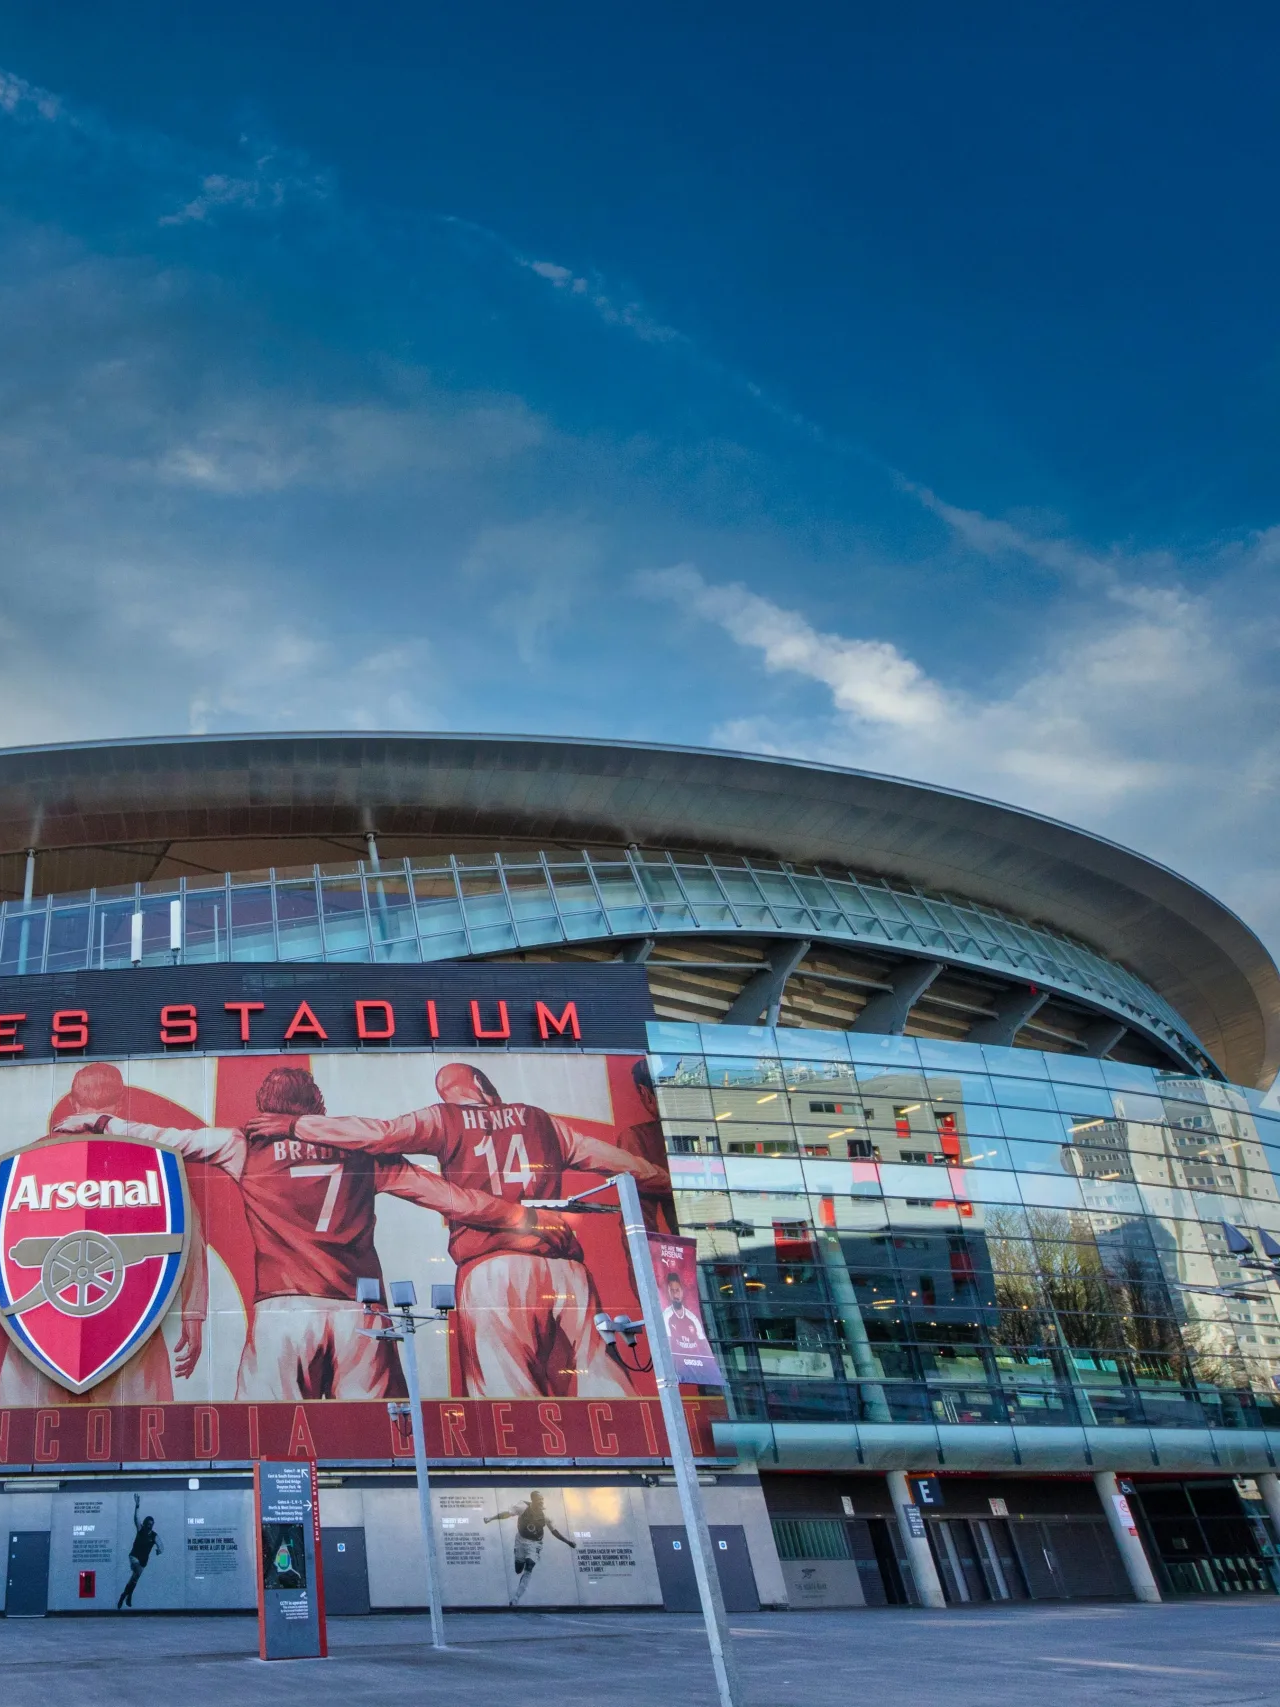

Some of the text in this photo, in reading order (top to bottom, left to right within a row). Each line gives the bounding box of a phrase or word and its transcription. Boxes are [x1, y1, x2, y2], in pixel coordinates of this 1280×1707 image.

[160, 1000, 582, 1044] STADIUM
[462, 1107, 526, 1130] HENRY
[474, 1134, 536, 1196] 14
[9, 1170, 161, 1212] Arsenal
[290, 1164, 344, 1232] 7
[661, 1250, 683, 1259] ARSENAL
[918, 1481, 933, 1503] E
